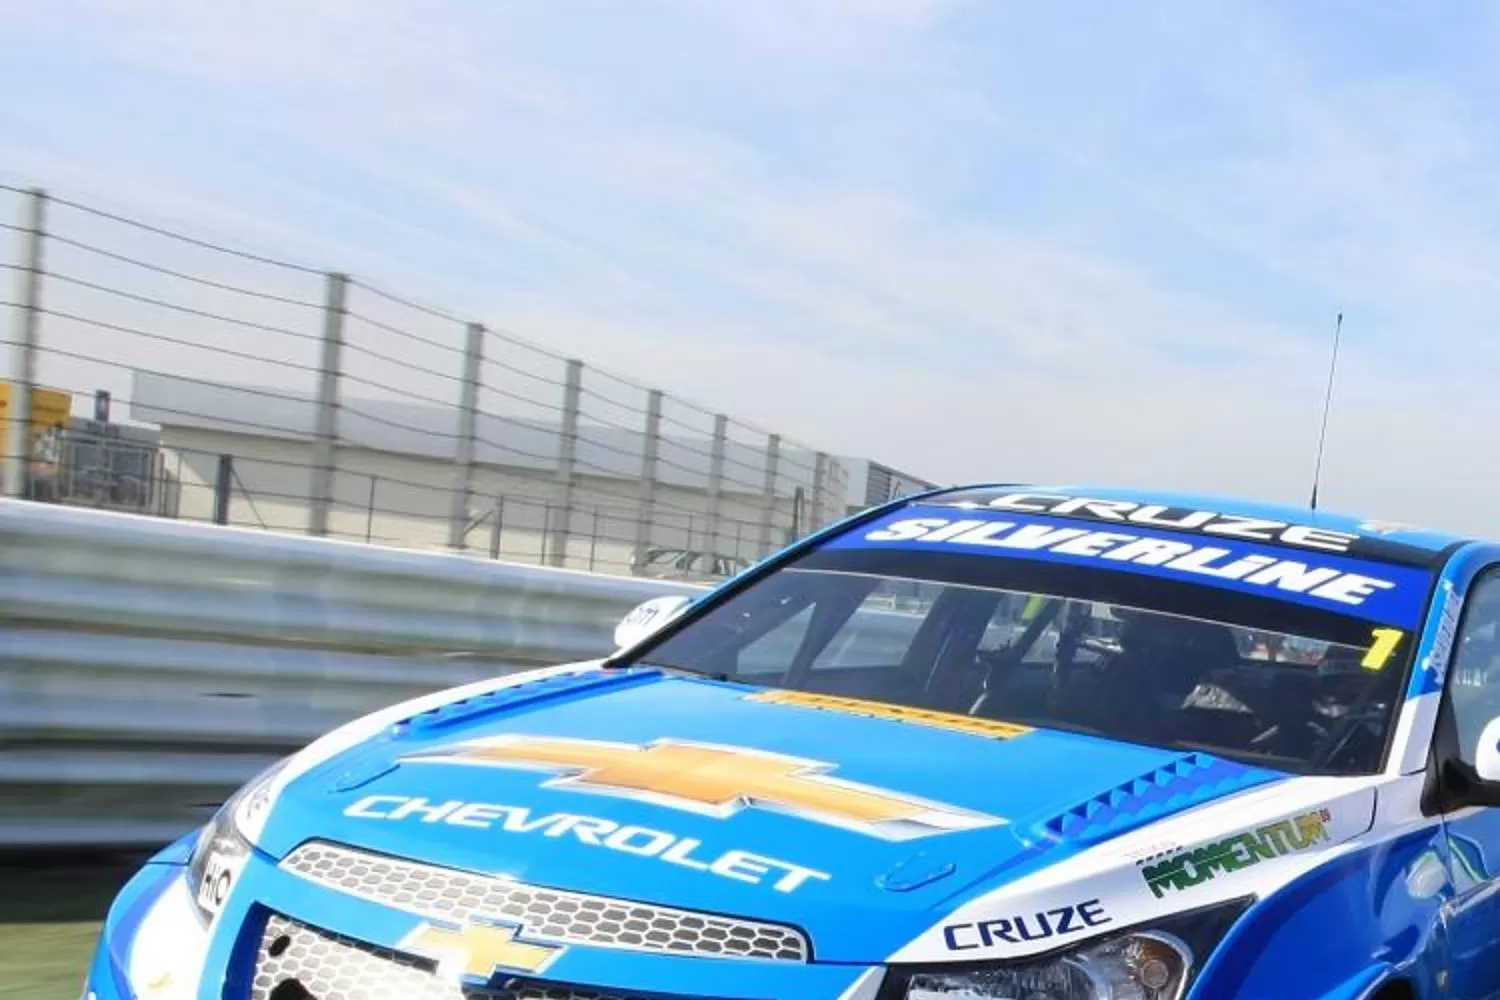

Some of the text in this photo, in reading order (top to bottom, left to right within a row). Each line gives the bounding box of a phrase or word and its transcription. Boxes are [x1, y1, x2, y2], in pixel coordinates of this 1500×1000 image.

[987, 493, 1360, 552] CRUZE
[864, 517, 1396, 605] SILVERLINE
[1360, 627, 1404, 672] 1
[342, 793, 832, 894] CHEVROLET
[943, 898, 1113, 952] CRUZE
